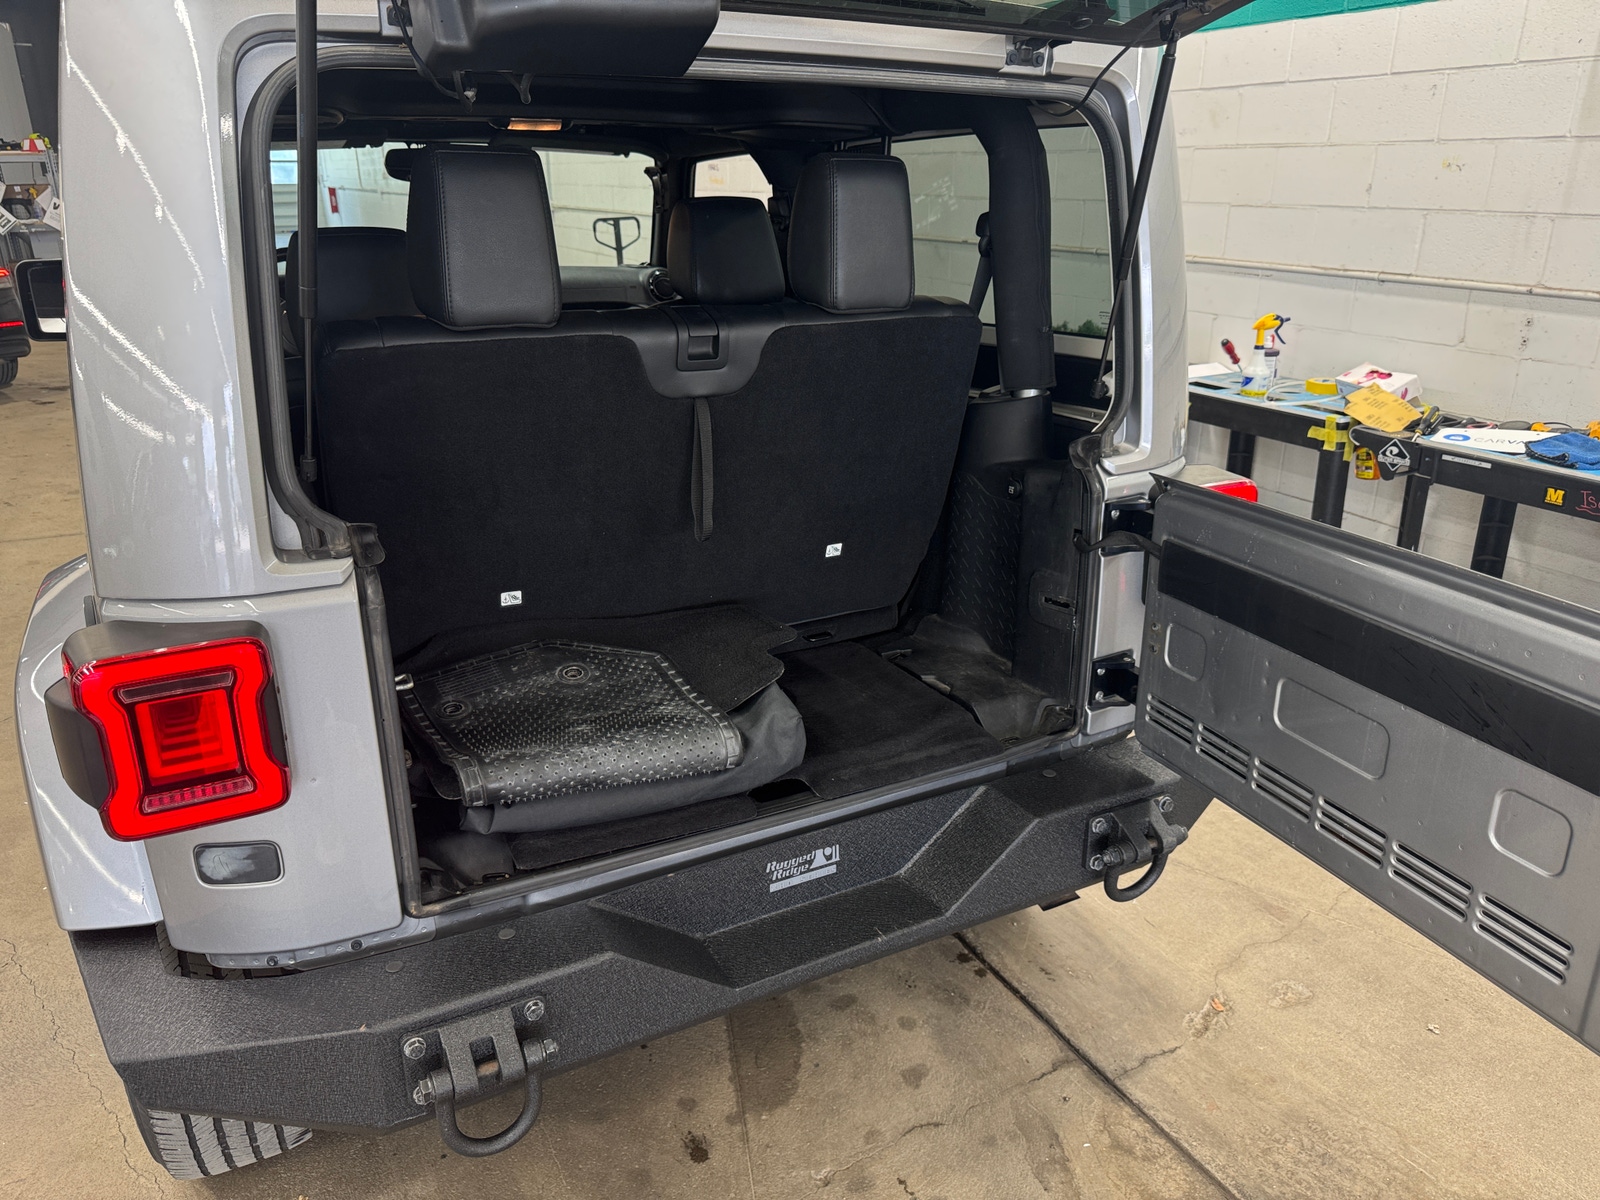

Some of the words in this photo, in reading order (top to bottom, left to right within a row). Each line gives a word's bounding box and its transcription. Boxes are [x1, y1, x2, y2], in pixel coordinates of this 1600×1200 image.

[1474, 437, 1526, 445] CARVA
[766, 851, 816, 873] Rugged
[772, 864, 809, 880] Ridge
